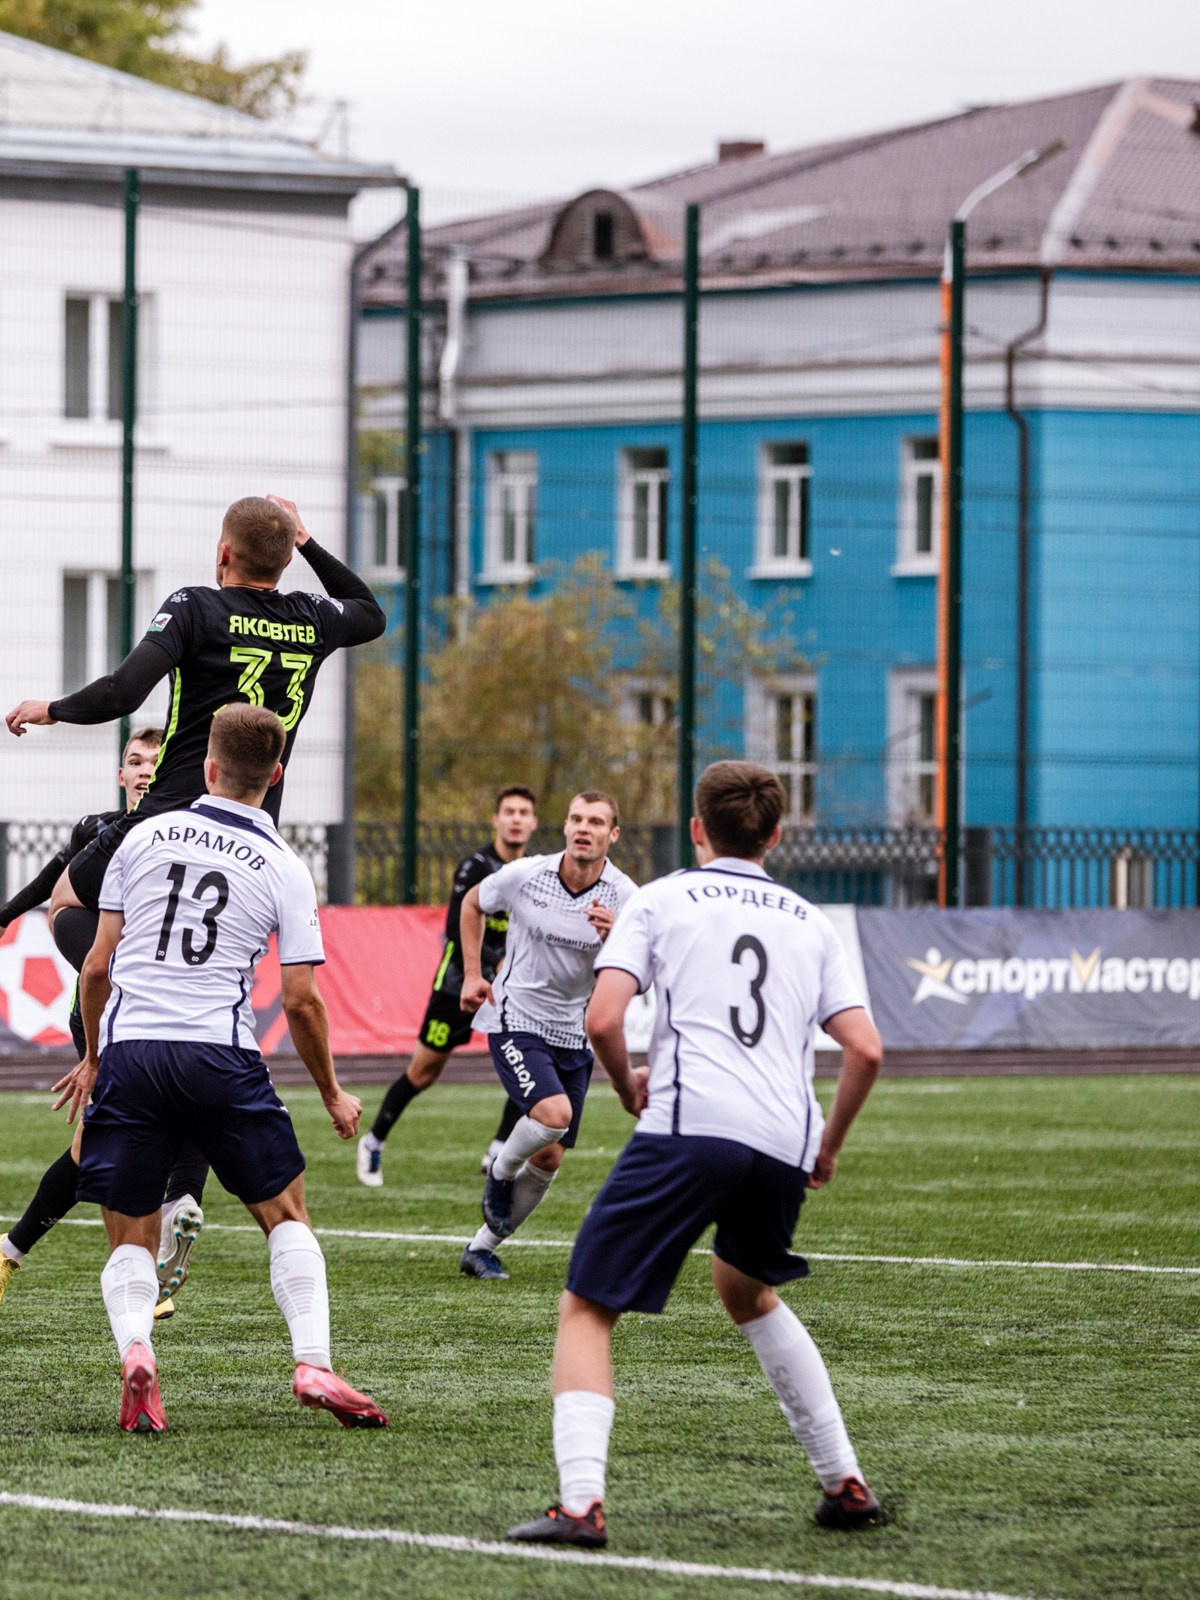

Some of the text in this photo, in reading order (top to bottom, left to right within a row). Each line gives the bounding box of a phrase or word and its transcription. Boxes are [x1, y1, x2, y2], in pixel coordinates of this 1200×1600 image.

[229, 615, 316, 644] ЯКОВЛЕВ
[151, 826, 267, 871] АБРАМОВ
[155, 863, 230, 966] 13
[686, 885, 809, 922] ГОРДЕЕВ
[730, 933, 768, 1049] 3
[426, 1018, 450, 1048] 18
